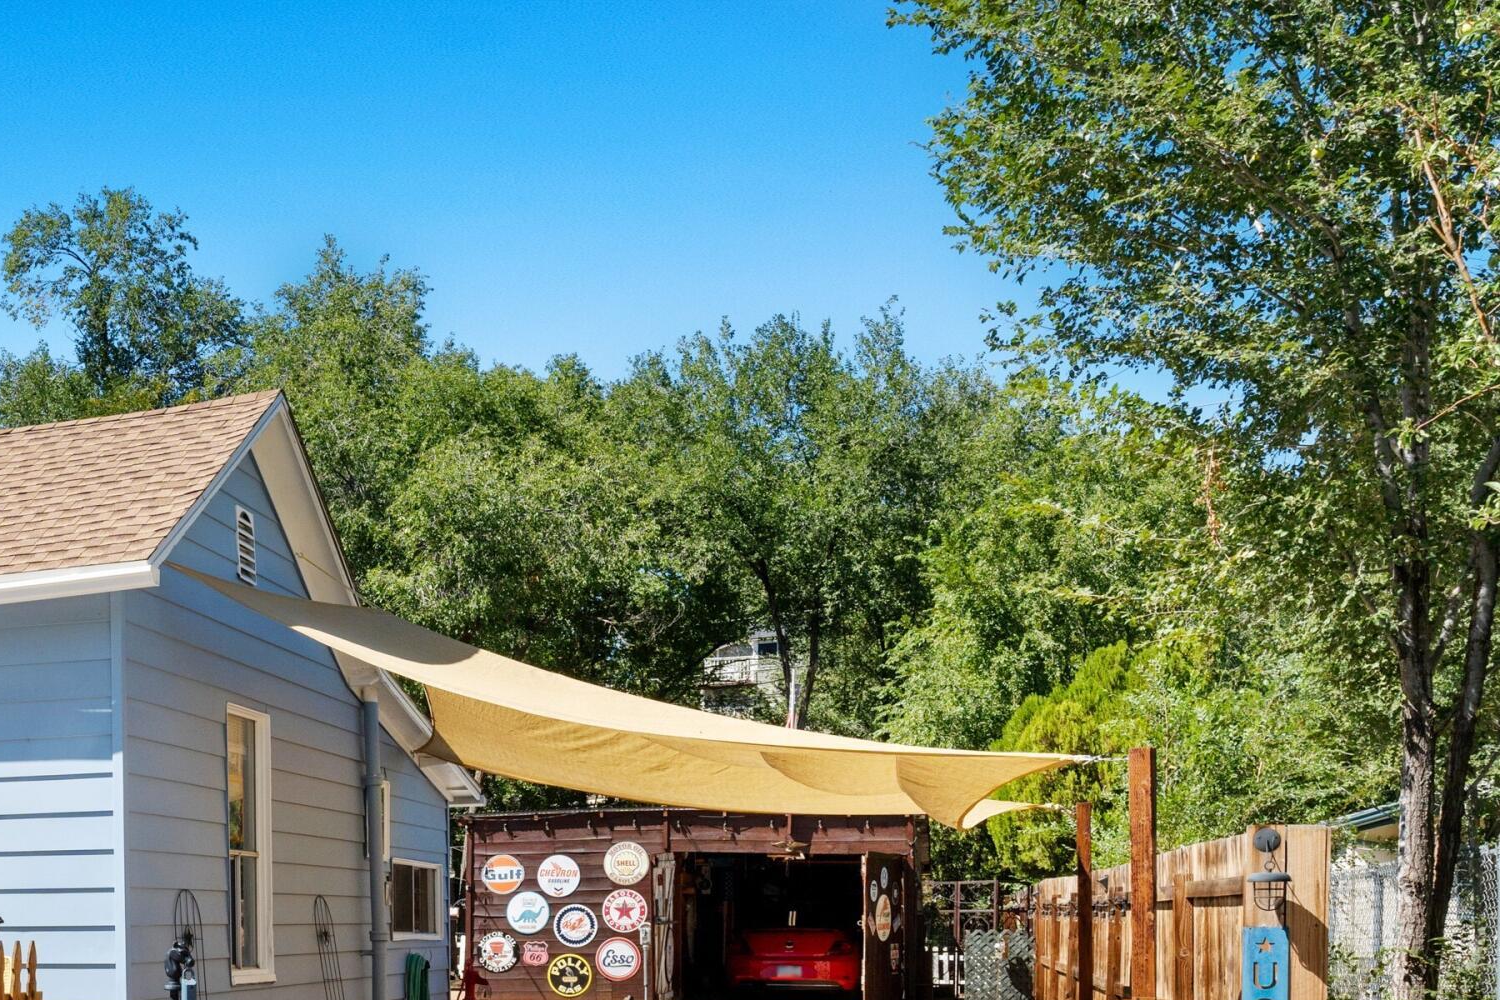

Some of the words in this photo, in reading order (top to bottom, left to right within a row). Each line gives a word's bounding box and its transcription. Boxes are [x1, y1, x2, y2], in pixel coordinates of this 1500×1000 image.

[609, 843, 632, 856] MOTOR
[485, 869, 522, 880] Gulf
[540, 867, 578, 878] CHEVRON
[606, 890, 644, 907] GASOLINE
[478, 931, 504, 947] MOTOR
[505, 934, 516, 947] OIL
[529, 953, 542, 961] 66
[603, 949, 634, 968] Esso
[479, 957, 517, 972] GASOLINE
[551, 957, 589, 976] POLLY
[558, 984, 582, 994] GAS
